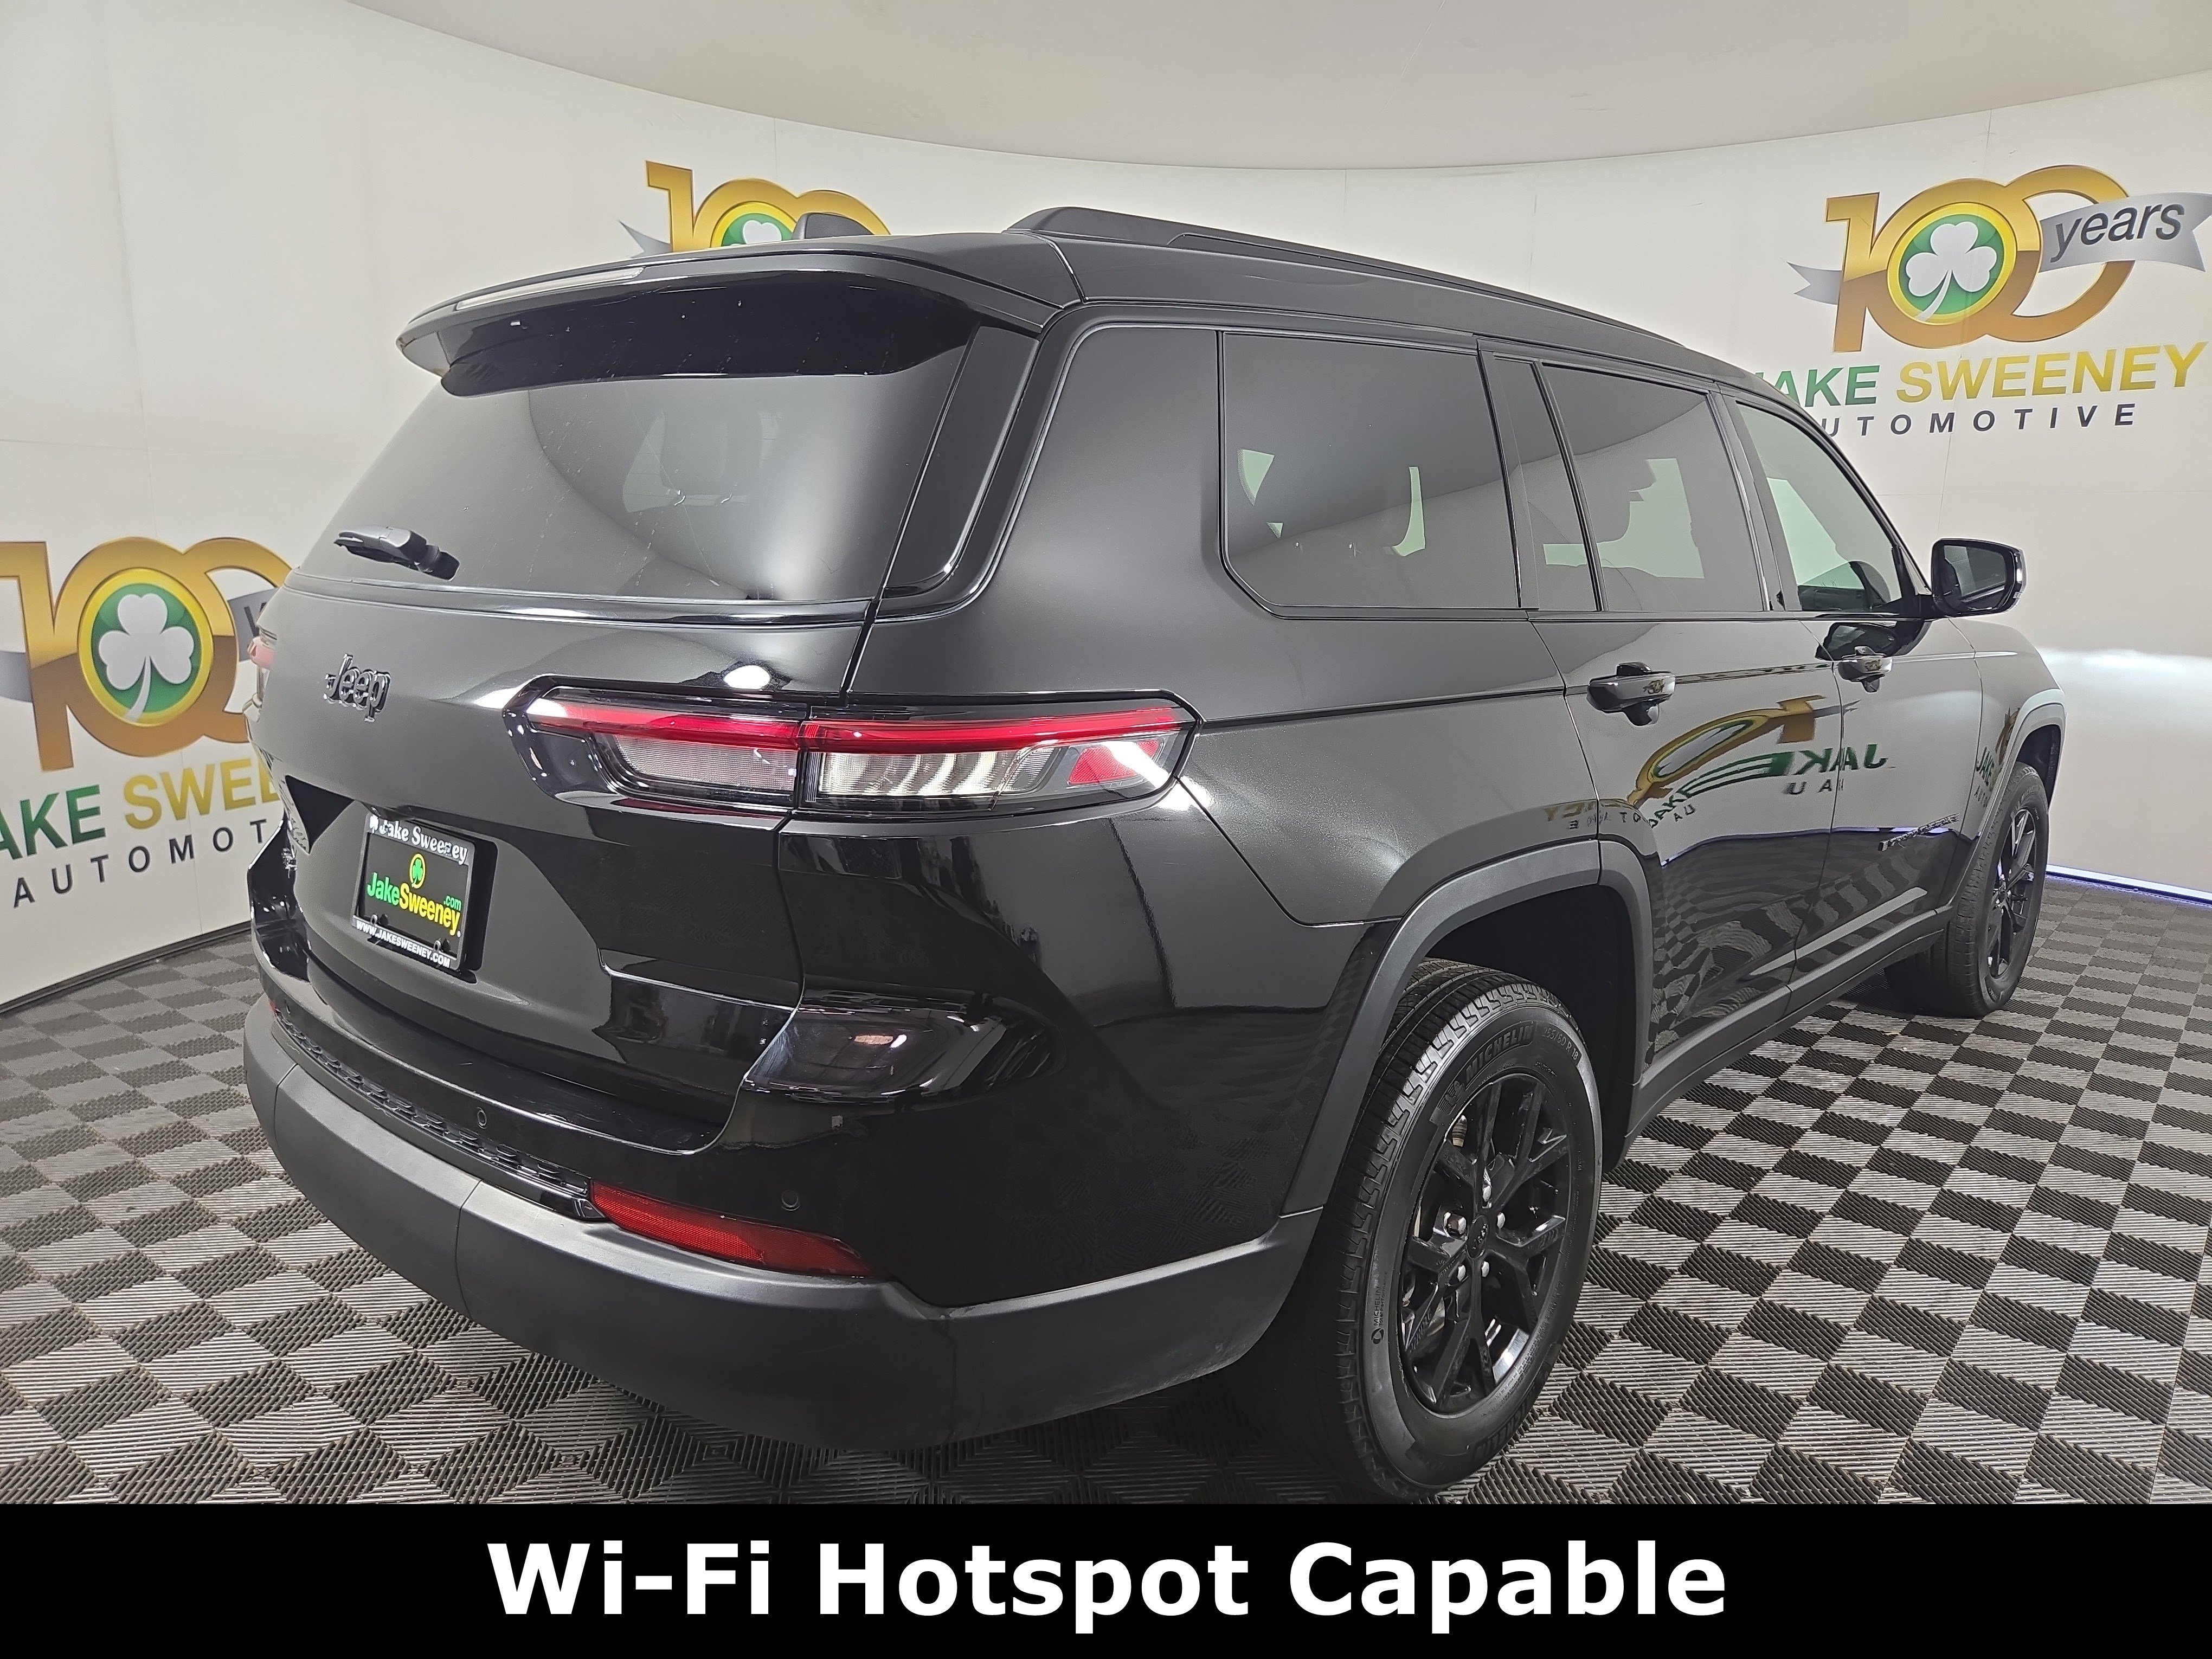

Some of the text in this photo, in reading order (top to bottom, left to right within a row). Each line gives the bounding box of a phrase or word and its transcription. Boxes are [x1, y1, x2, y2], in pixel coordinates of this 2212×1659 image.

[1825, 164, 2184, 353] 100 years
[1755, 340, 2209, 408] AKE SWEENEY
[1820, 402, 2136, 437] UTOMOTIVE
[324, 653, 391, 722] Jeep
[0, 784, 106, 860] AKE
[380, 819, 468, 865] Jake Sweeney
[14, 819, 267, 908] AUTOMOT
[356, 919, 451, 968] WWW.JAKESWEENEY.COM
[1465, 1024, 1535, 1083] MICHELIN
[1373, 1286, 1381, 1327] MICHELIN
